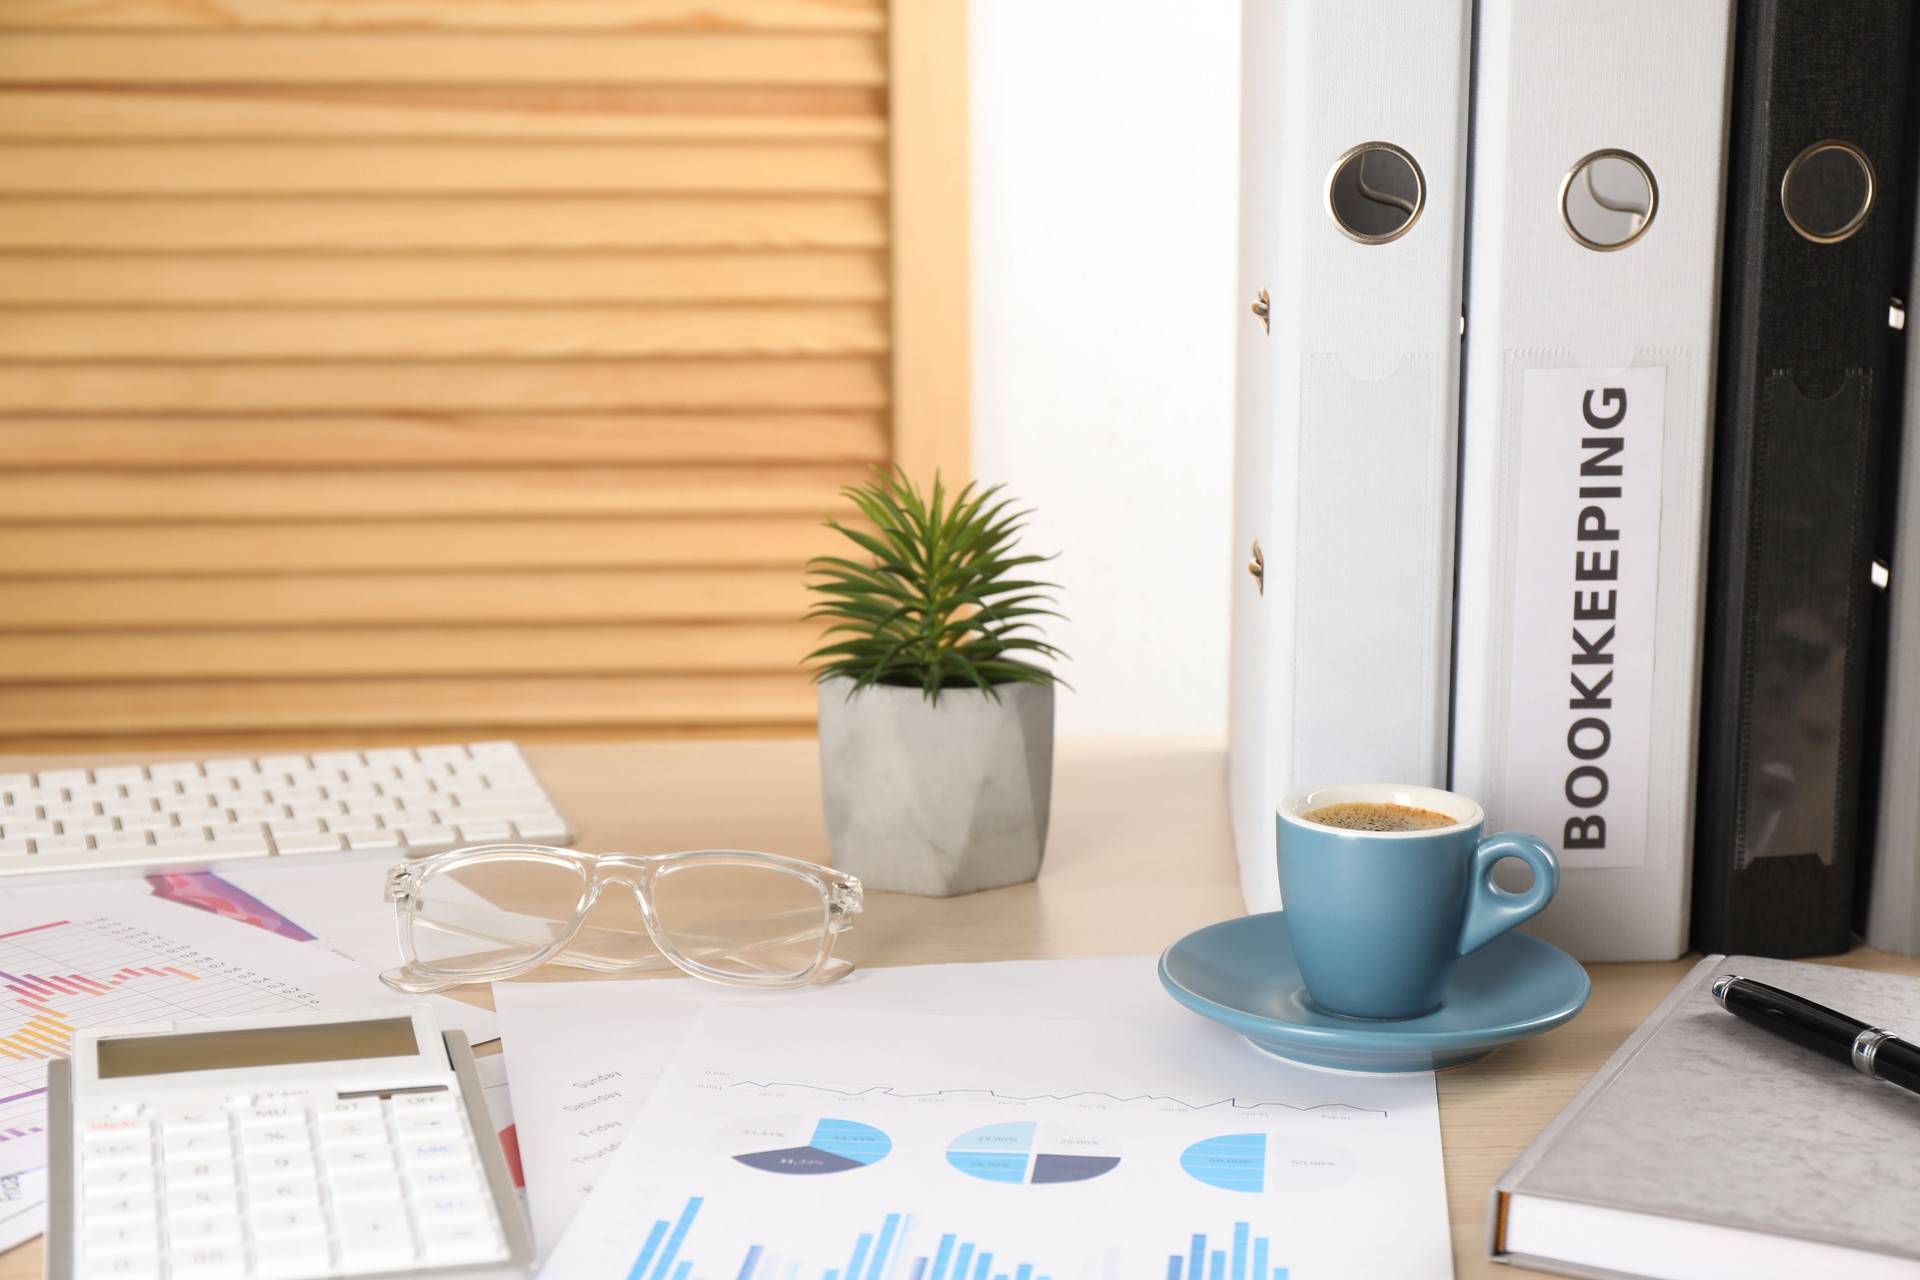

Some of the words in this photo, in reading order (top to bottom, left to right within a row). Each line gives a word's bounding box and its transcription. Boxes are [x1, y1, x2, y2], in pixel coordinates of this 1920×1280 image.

[1563, 387, 1628, 850] BOOKKEEPING
[572, 1071, 622, 1089] Sunday
[562, 1091, 622, 1112] Saturday
[578, 1121, 622, 1138] Friday
